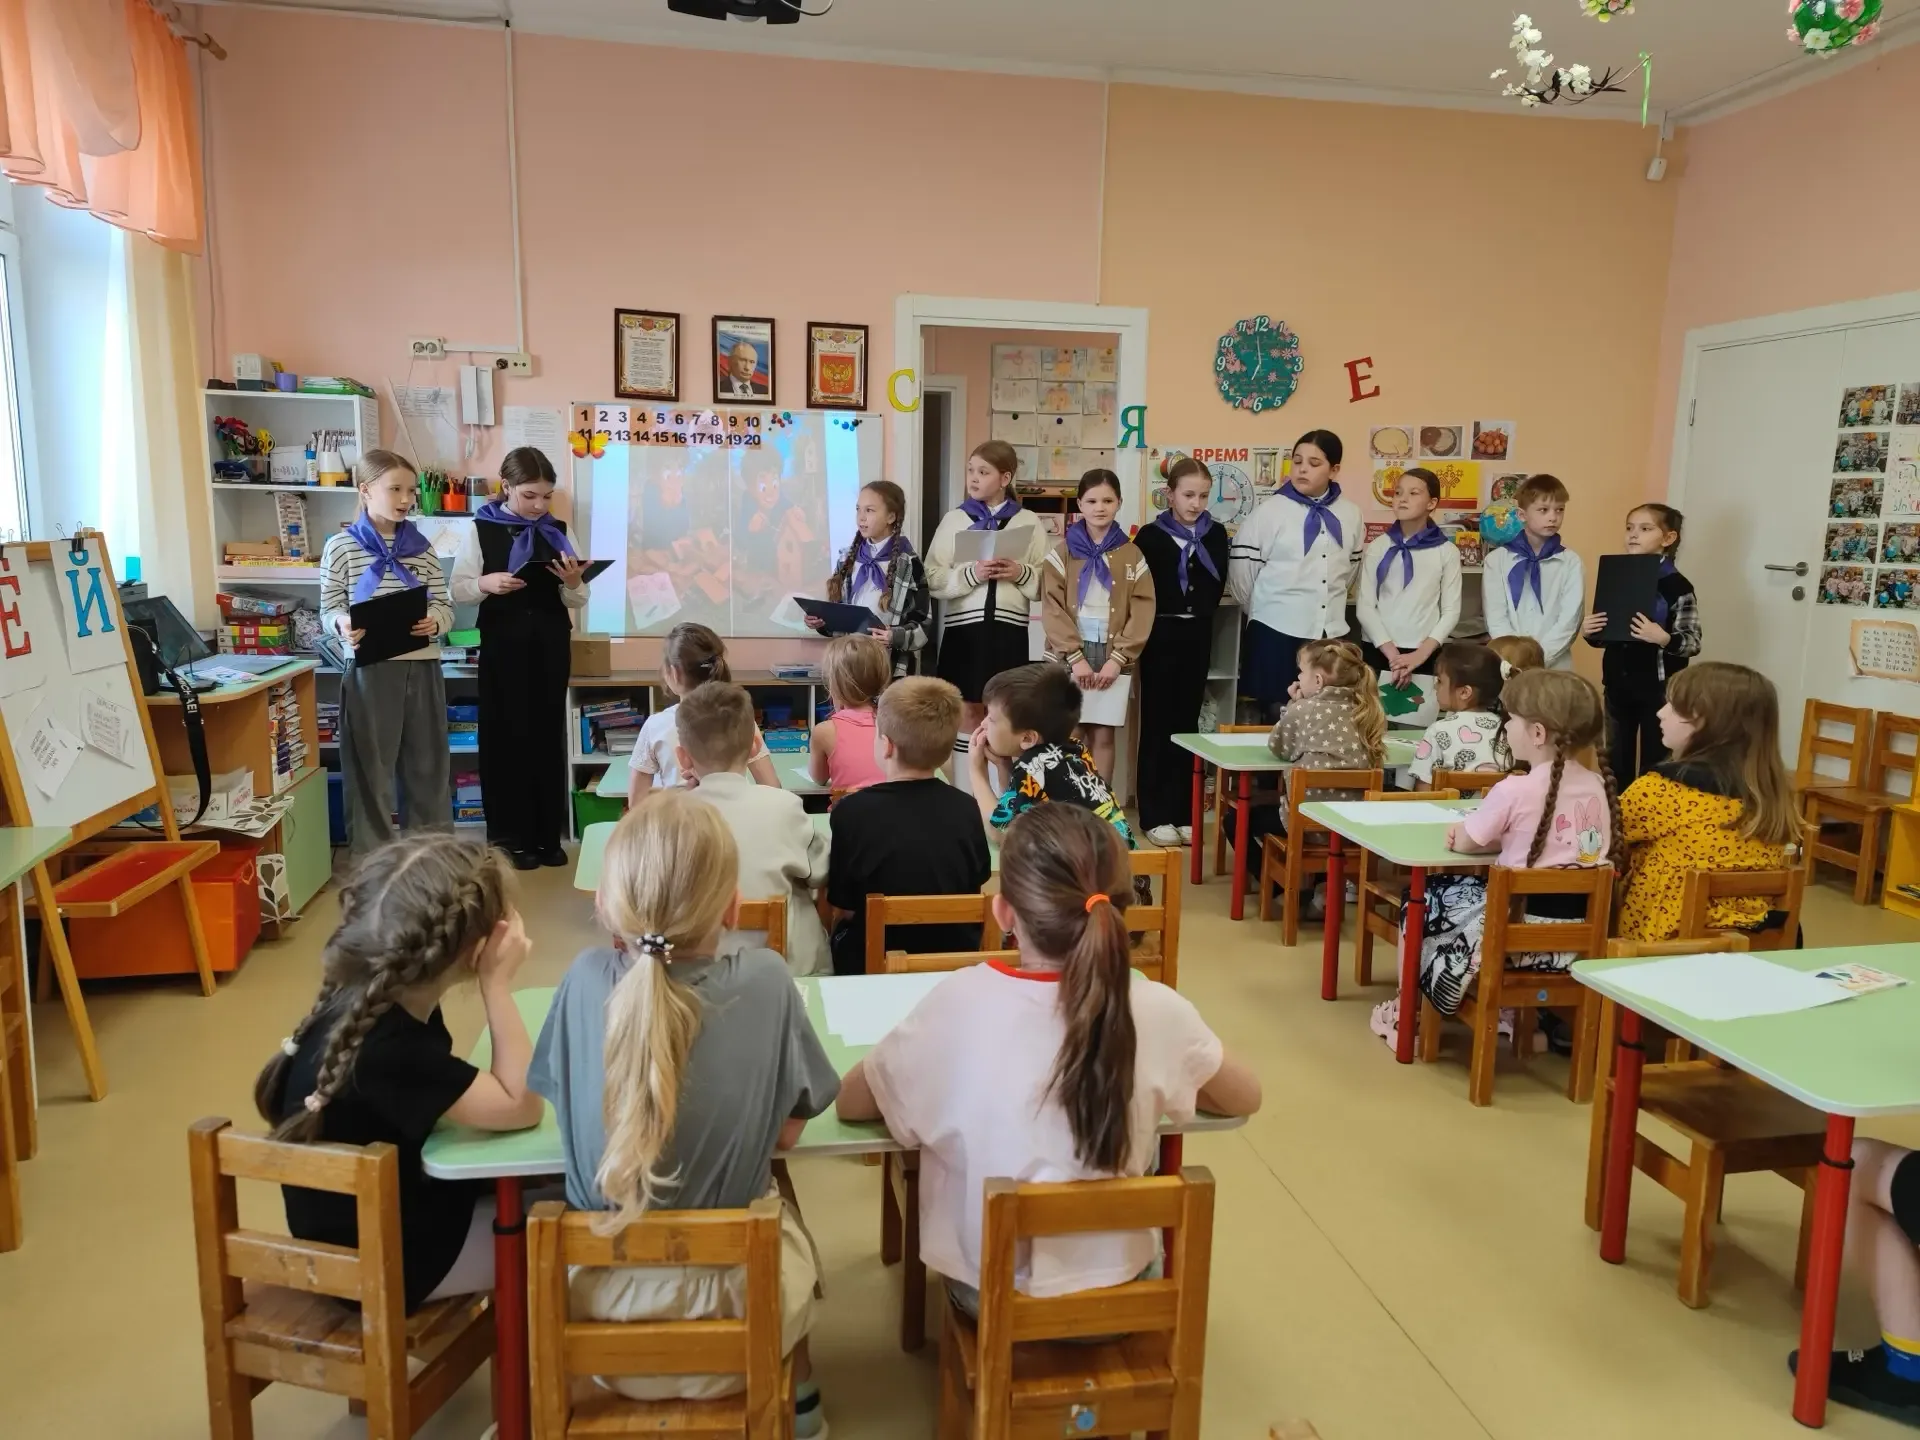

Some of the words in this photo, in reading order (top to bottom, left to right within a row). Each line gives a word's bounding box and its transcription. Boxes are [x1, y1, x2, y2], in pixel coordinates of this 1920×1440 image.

[1238, 322, 1246, 332] 11
[1254, 316, 1269, 332] 12
[1279, 322, 1285, 332] 1
[1221, 337, 1234, 347] 10
[1291, 338, 1298, 348] 2
[1216, 356, 1226, 371] 9
[1294, 356, 1303, 372] 3
[1221, 380, 1229, 390] 8
[1290, 380, 1297, 391] 4
[1344, 356, 1380, 403] Е
[888, 368, 920, 412] С
[1235, 396, 1242, 406] 7
[1253, 397, 1263, 412] 6
[1274, 396, 1282, 406] 5
[581, 410, 588, 421] 1
[600, 411, 608, 422] 2
[618, 412, 627, 422] 3
[637, 412, 647, 423] 4
[656, 413, 665, 424] 5
[675, 414, 683, 425] 6
[692, 414, 701, 425] 7
[711, 415, 719, 426] 8
[729, 416, 737, 427] 9
[744, 416, 760, 428] 10
[1117, 405, 1148, 448] Я
[615, 430, 631, 441] 13
[634, 431, 650, 442] 14
[653, 432, 668, 443] 15
[672, 432, 687, 444] 16
[690, 433, 706, 444] 17
[708, 434, 723, 444] 18
[726, 434, 742, 445] 19
[744, 435, 761, 446] 20
[1192, 448, 1249, 462] ВРЕМЯ
[66, 550, 115, 638] Й
